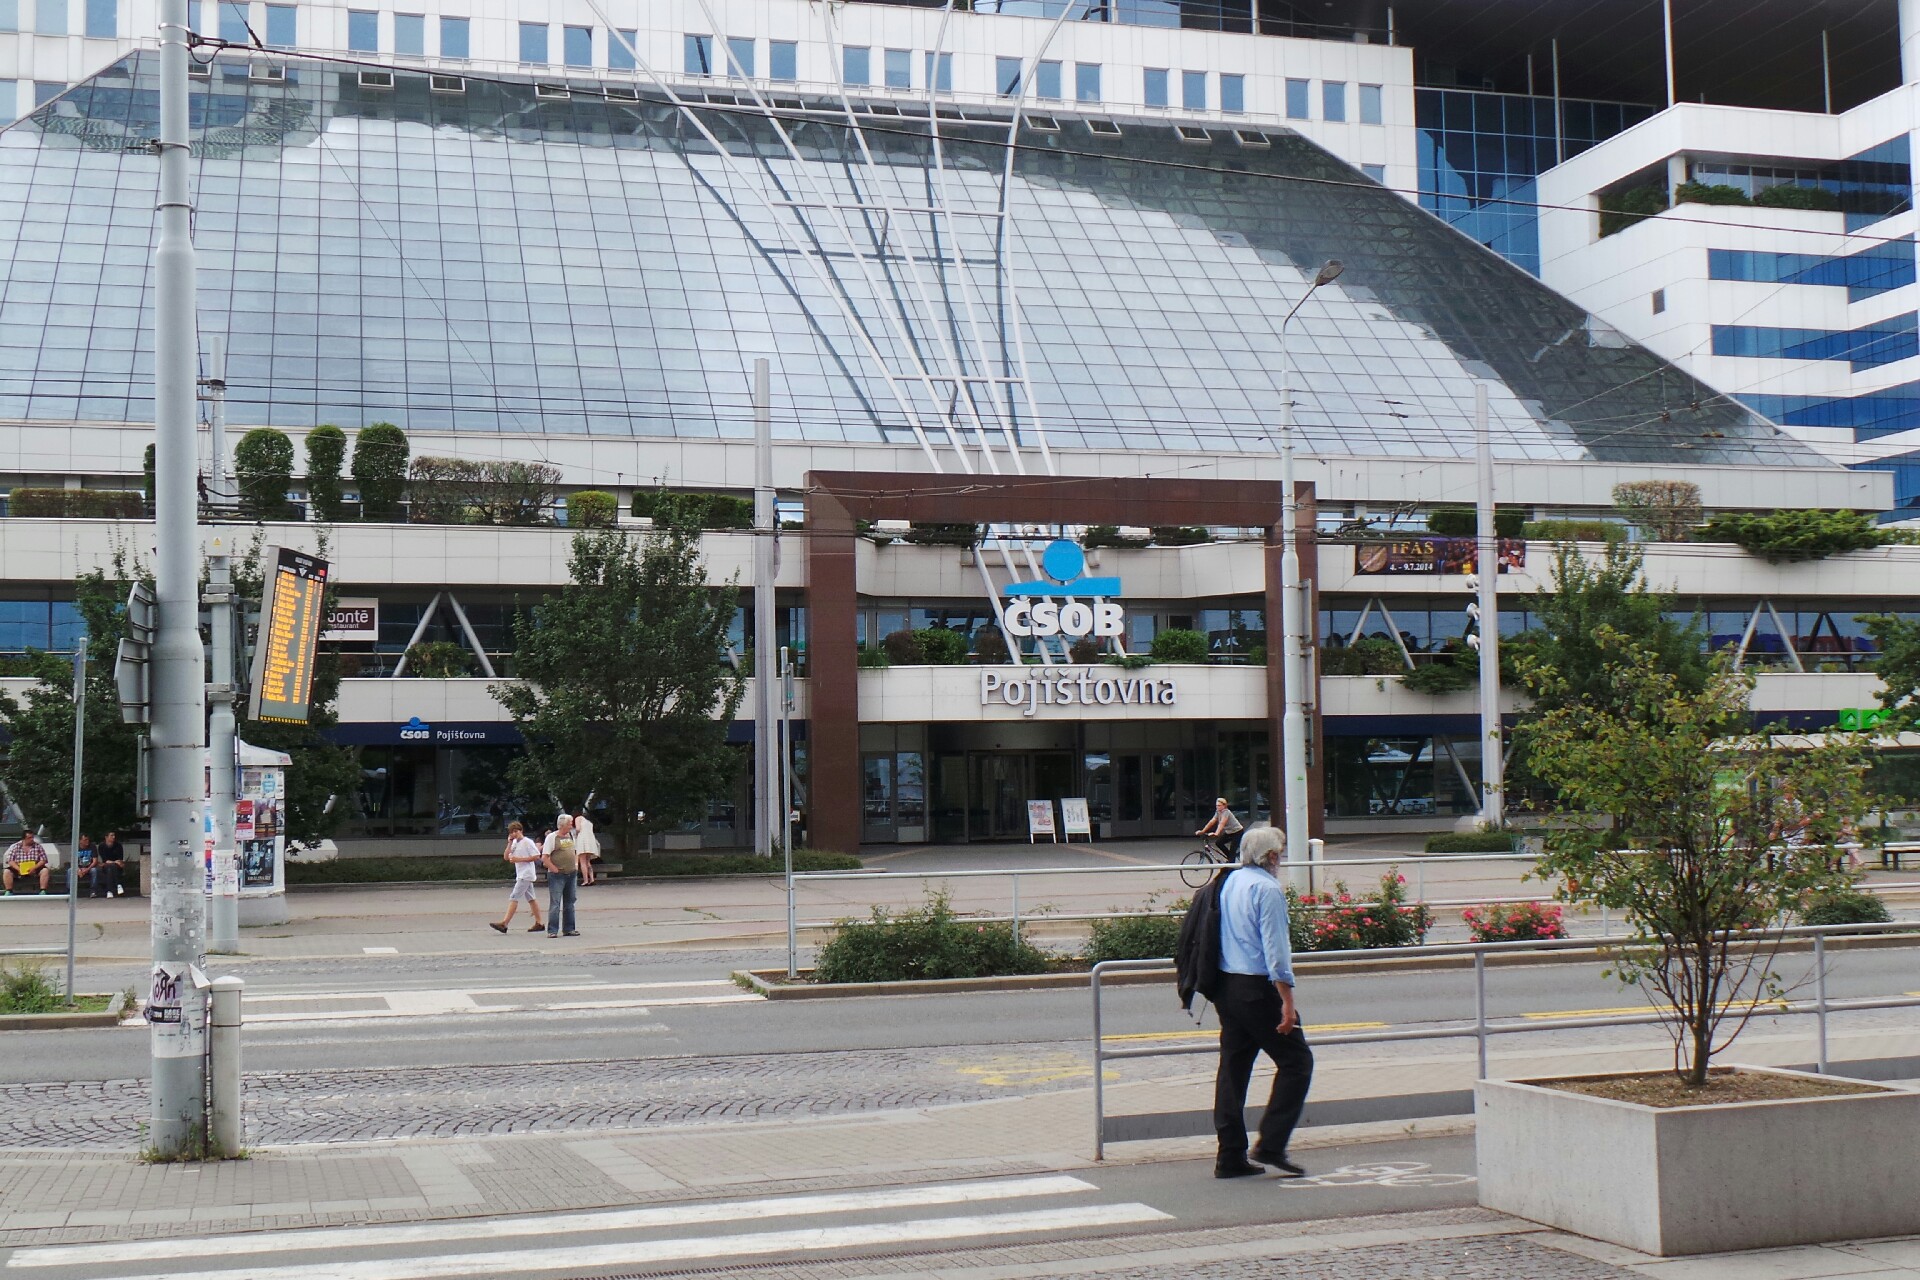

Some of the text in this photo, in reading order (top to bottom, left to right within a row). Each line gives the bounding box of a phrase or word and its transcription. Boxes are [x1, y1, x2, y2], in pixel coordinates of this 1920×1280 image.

[1392, 541, 1434, 554] IFAS
[1403, 563, 1433, 571] 9.7.2014
[1003, 597, 1124, 637] ČSOB
[980, 667, 1178, 716] Pojišťovna
[400, 730, 486, 741] ČSOB Pojišťovna
